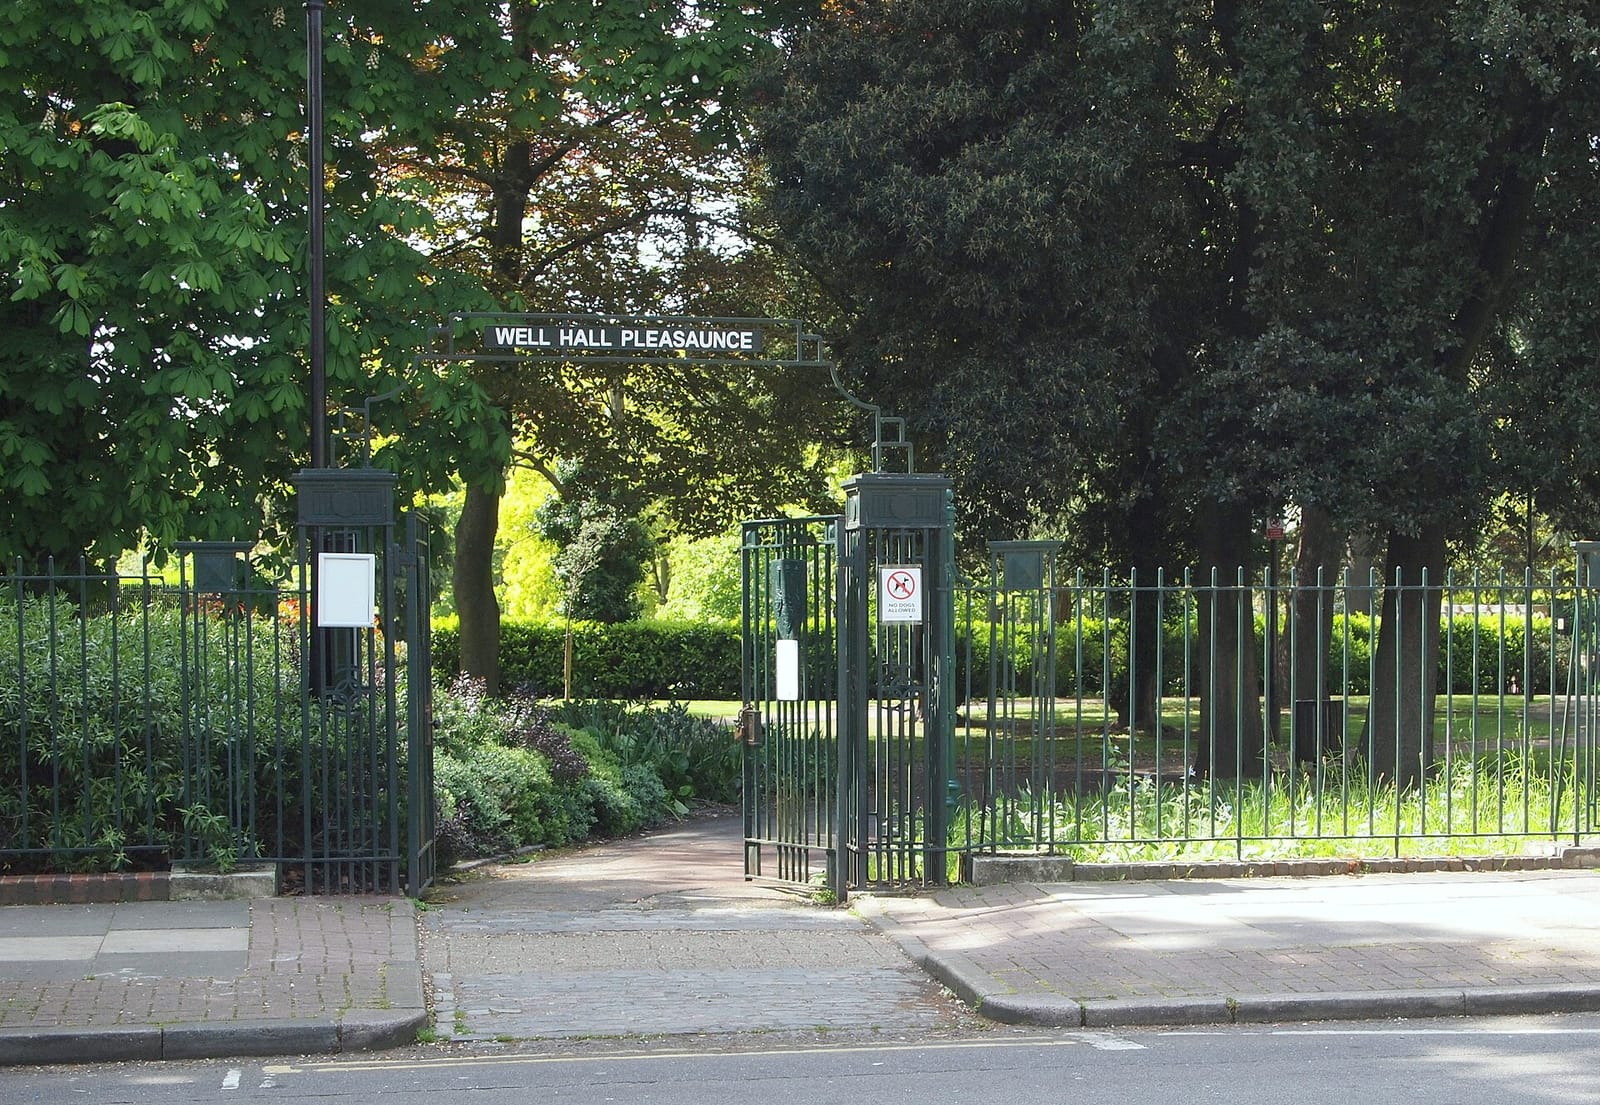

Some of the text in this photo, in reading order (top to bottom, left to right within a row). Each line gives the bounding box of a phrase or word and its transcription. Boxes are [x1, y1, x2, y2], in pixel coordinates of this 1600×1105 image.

[495, 327, 753, 349] WELL HALL PLEASAUNCE
